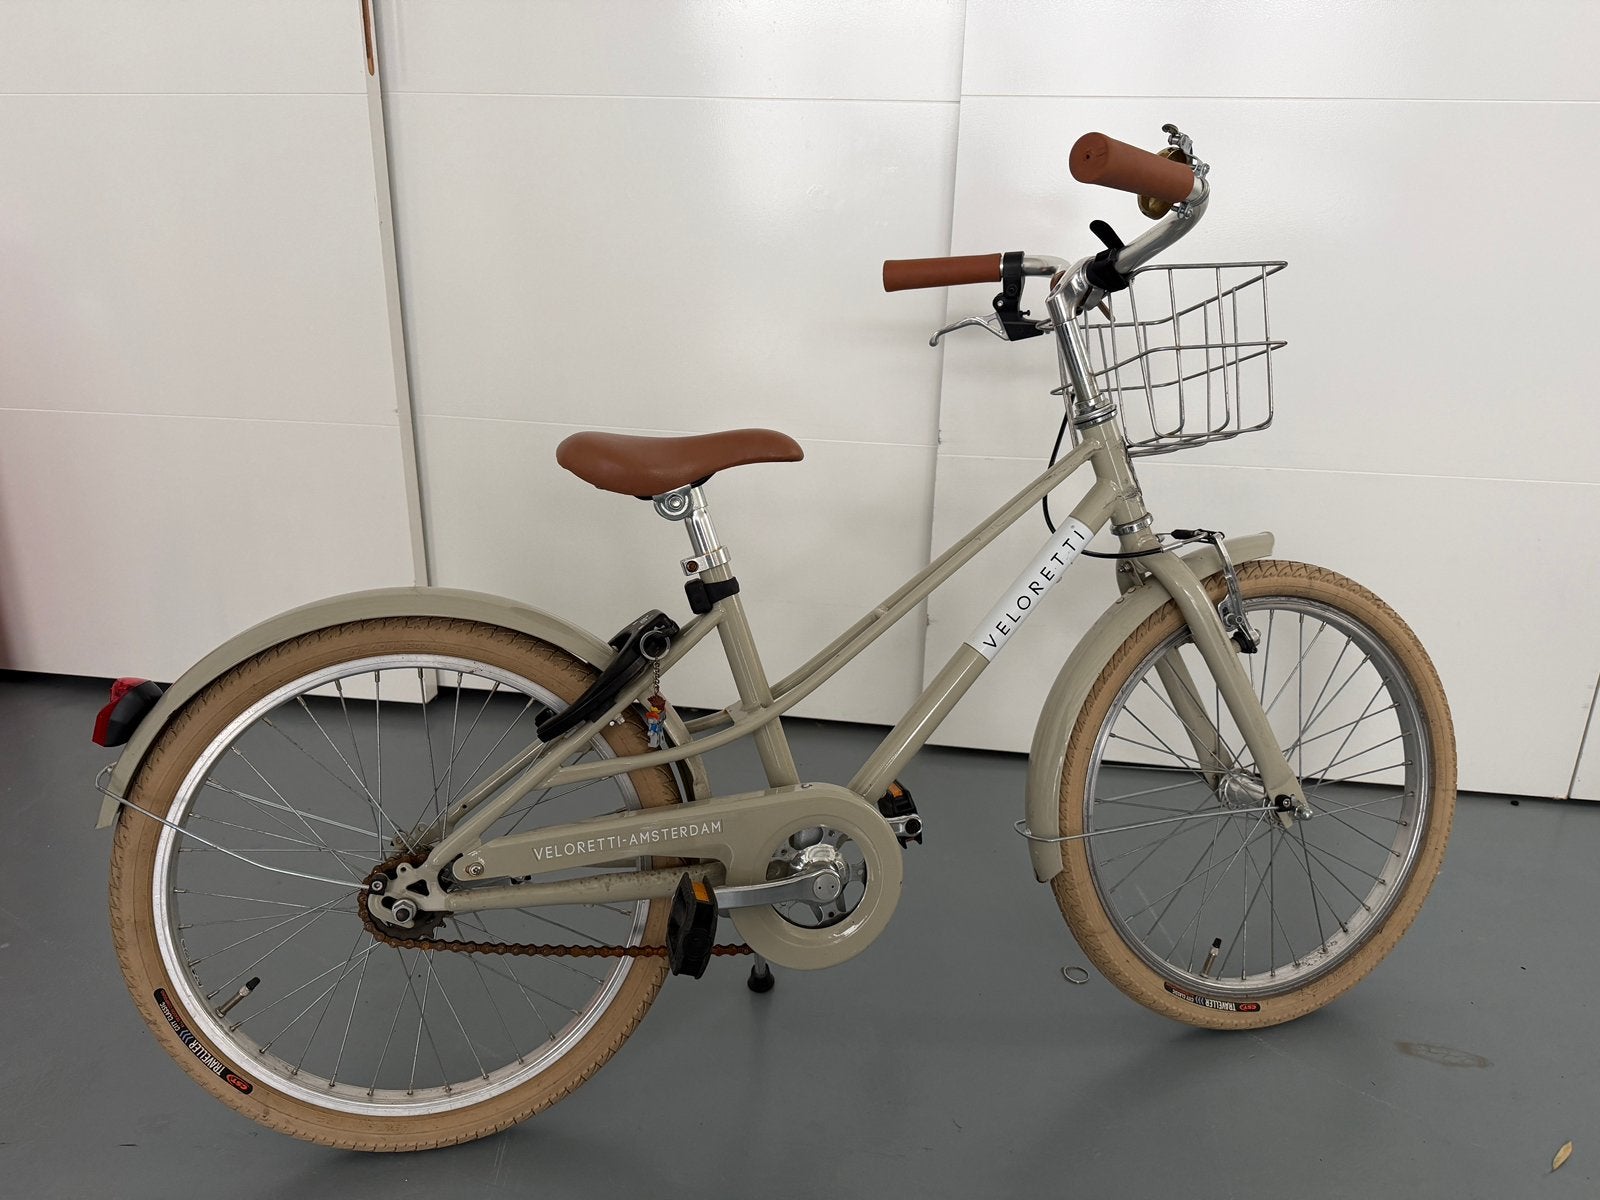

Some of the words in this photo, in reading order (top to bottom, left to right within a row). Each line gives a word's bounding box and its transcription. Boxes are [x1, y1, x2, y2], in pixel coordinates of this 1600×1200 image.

[983, 530, 1085, 648] VELORETTI
[533, 821, 722, 861] VELORETTI-AMSTERDAM
[1205, 998, 1236, 1011] TRAVELLER
[188, 1039, 226, 1076] TRAVELLER
[229, 1075, 248, 1091] CST
